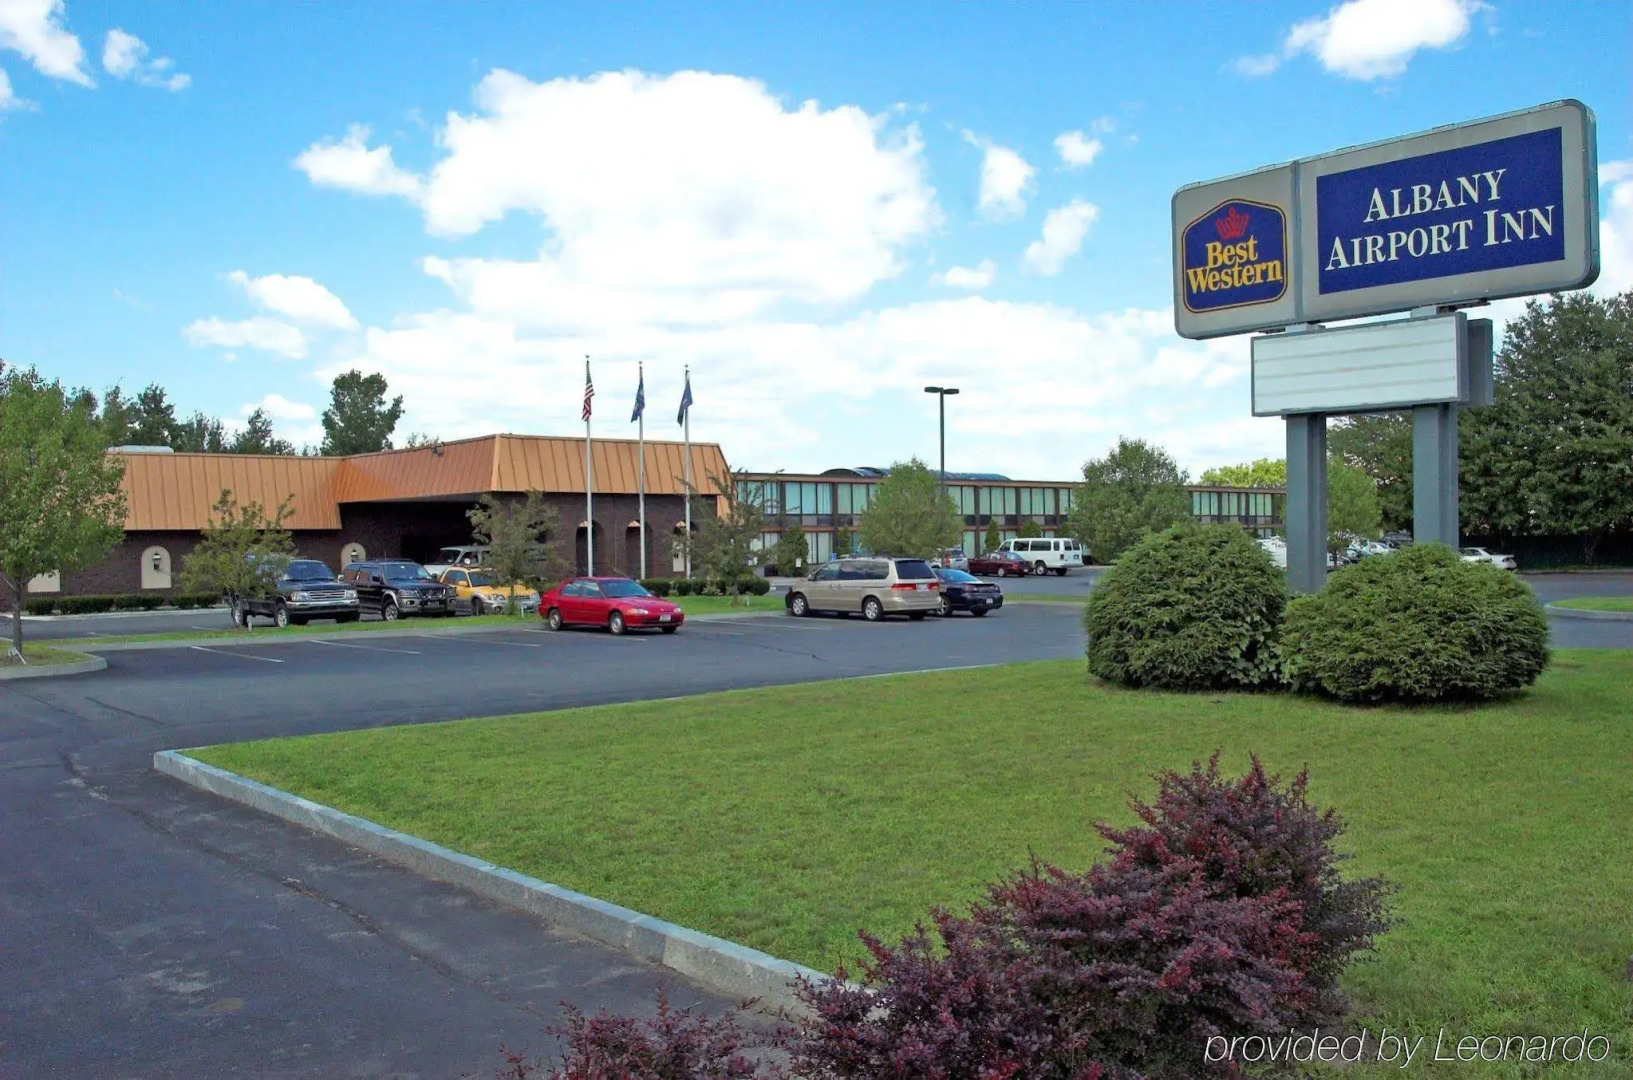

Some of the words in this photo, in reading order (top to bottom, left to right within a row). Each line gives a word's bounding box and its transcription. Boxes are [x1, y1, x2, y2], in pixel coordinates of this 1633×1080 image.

[1363, 169, 1507, 223] ALBANY
[1206, 234, 1258, 264] Best
[1325, 219, 1473, 271] AIRPORT
[1483, 205, 1555, 246] INN
[1187, 259, 1283, 294] Western
